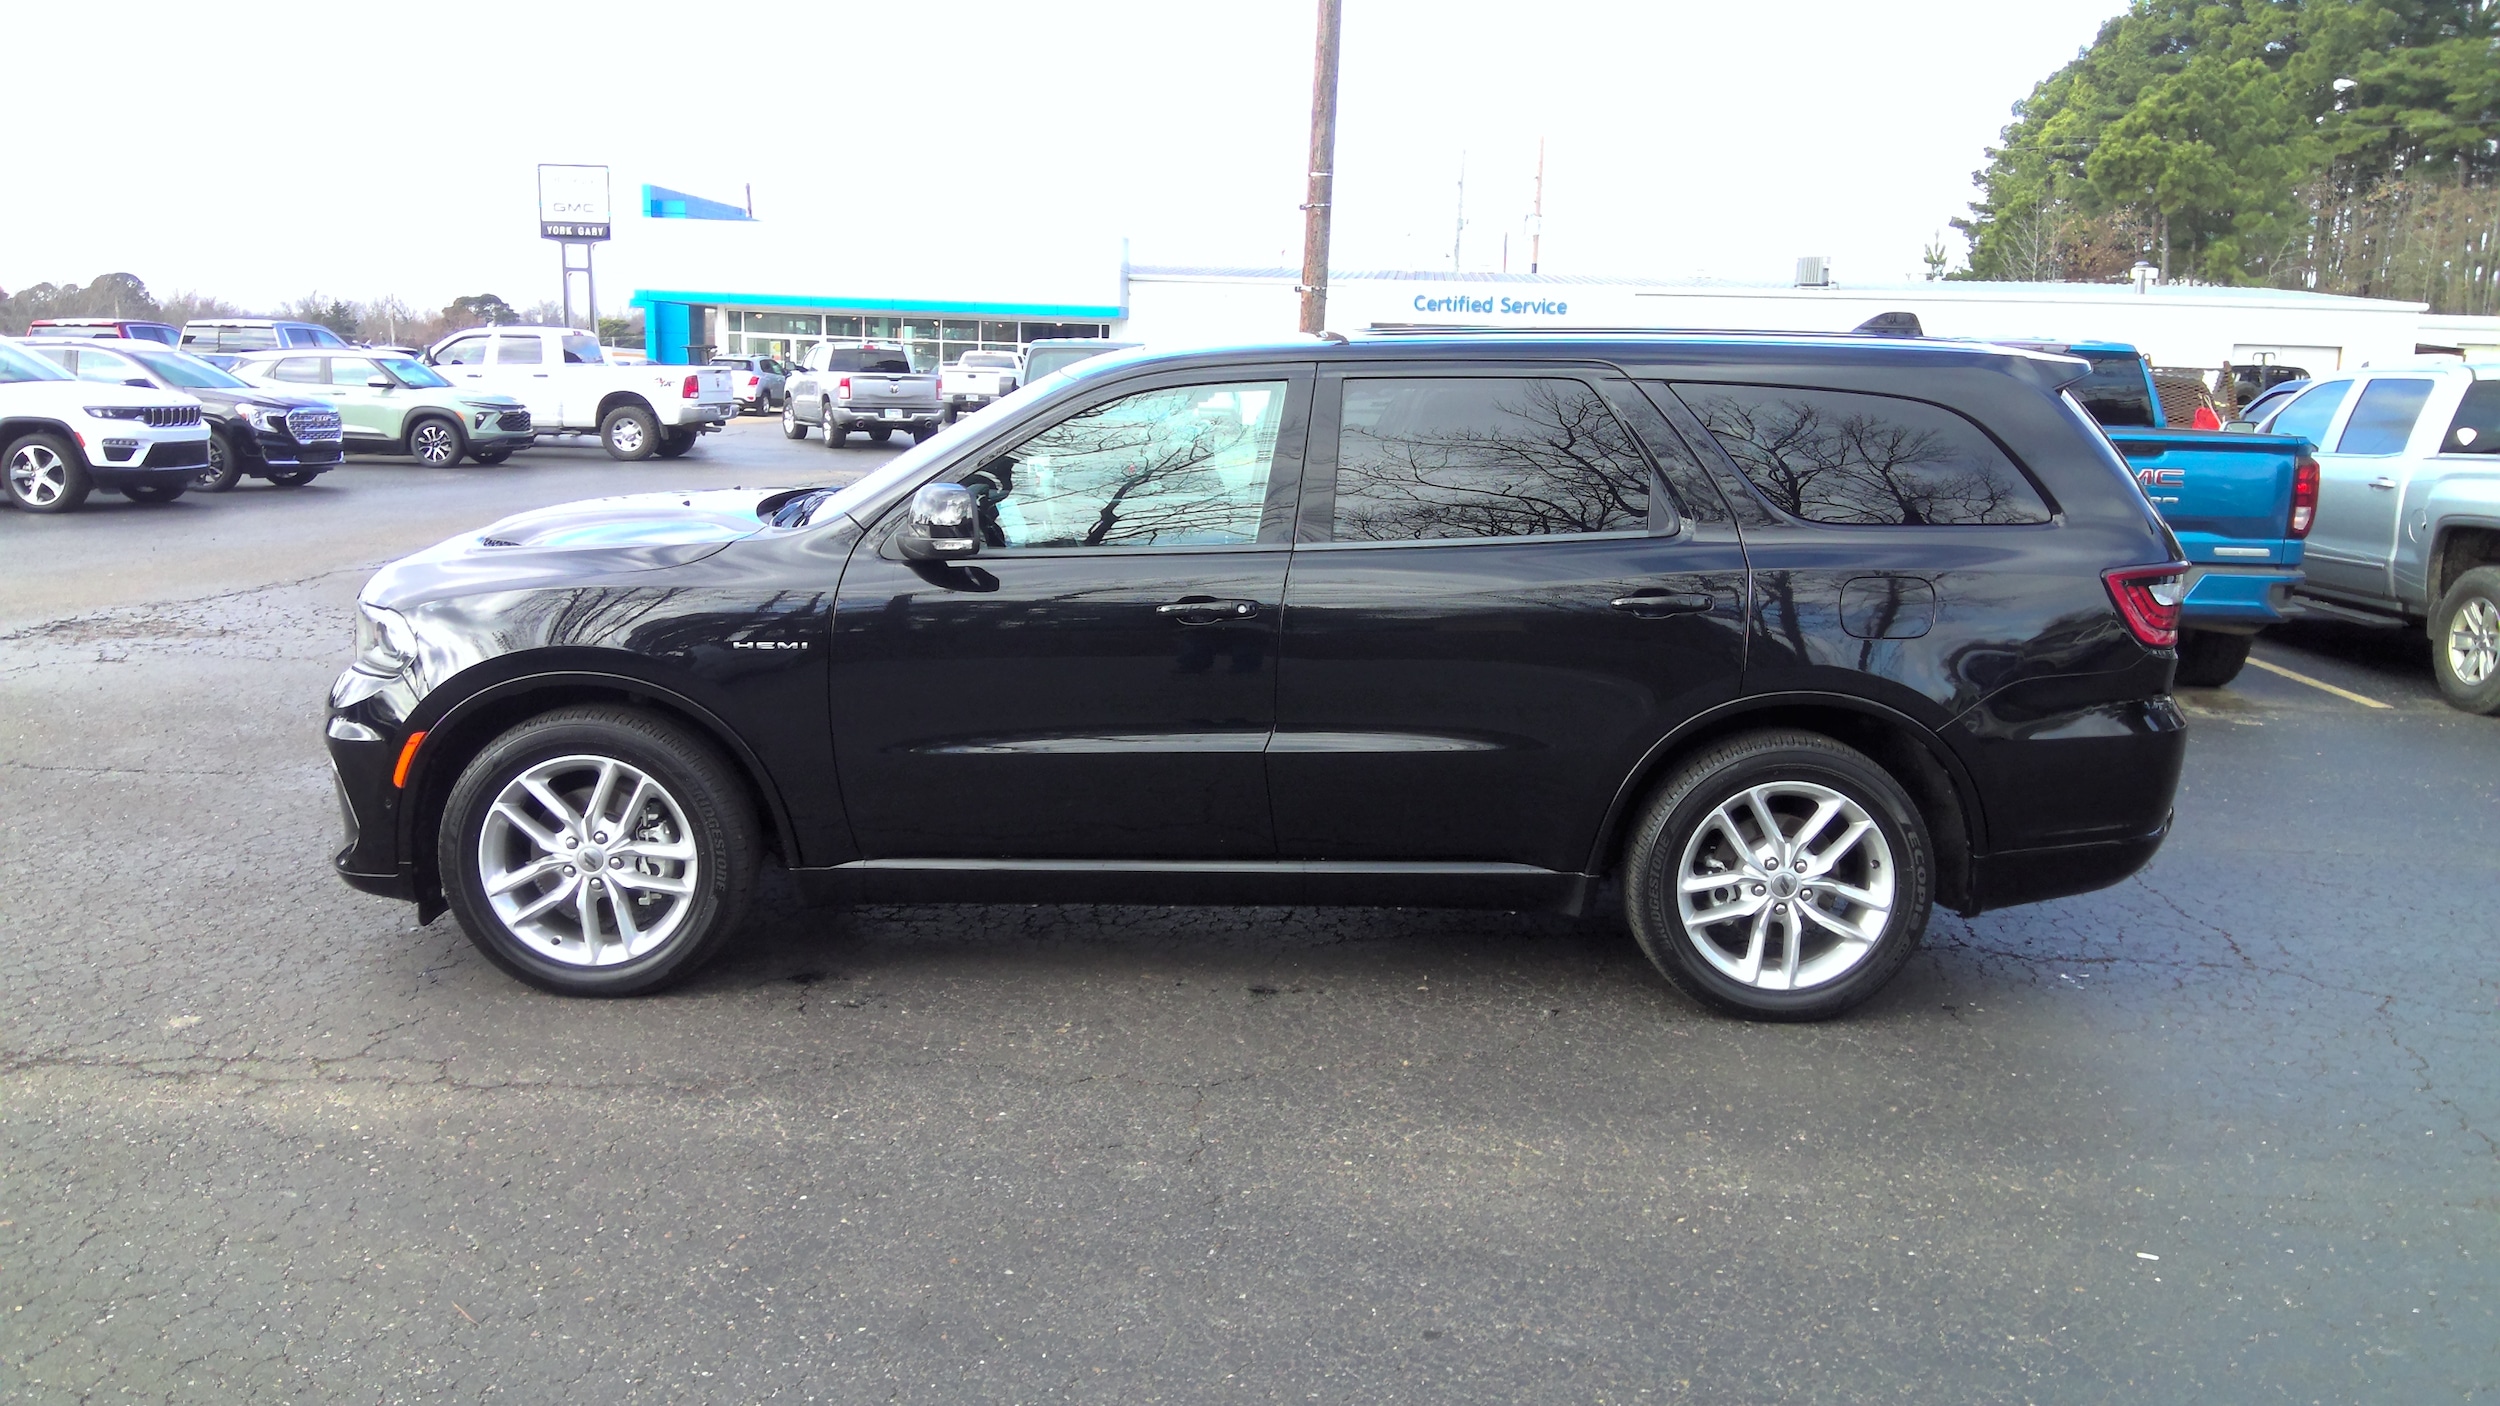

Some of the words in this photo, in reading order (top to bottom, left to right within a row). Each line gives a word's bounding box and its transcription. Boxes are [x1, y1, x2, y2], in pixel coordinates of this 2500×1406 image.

[553, 202, 595, 213] GMC
[546, 225, 573, 235] YORK
[1414, 294, 1494, 313] Certified
[1500, 297, 1568, 315] Service
[2137, 468, 2185, 487] MC
[732, 641, 809, 649] HEMI
